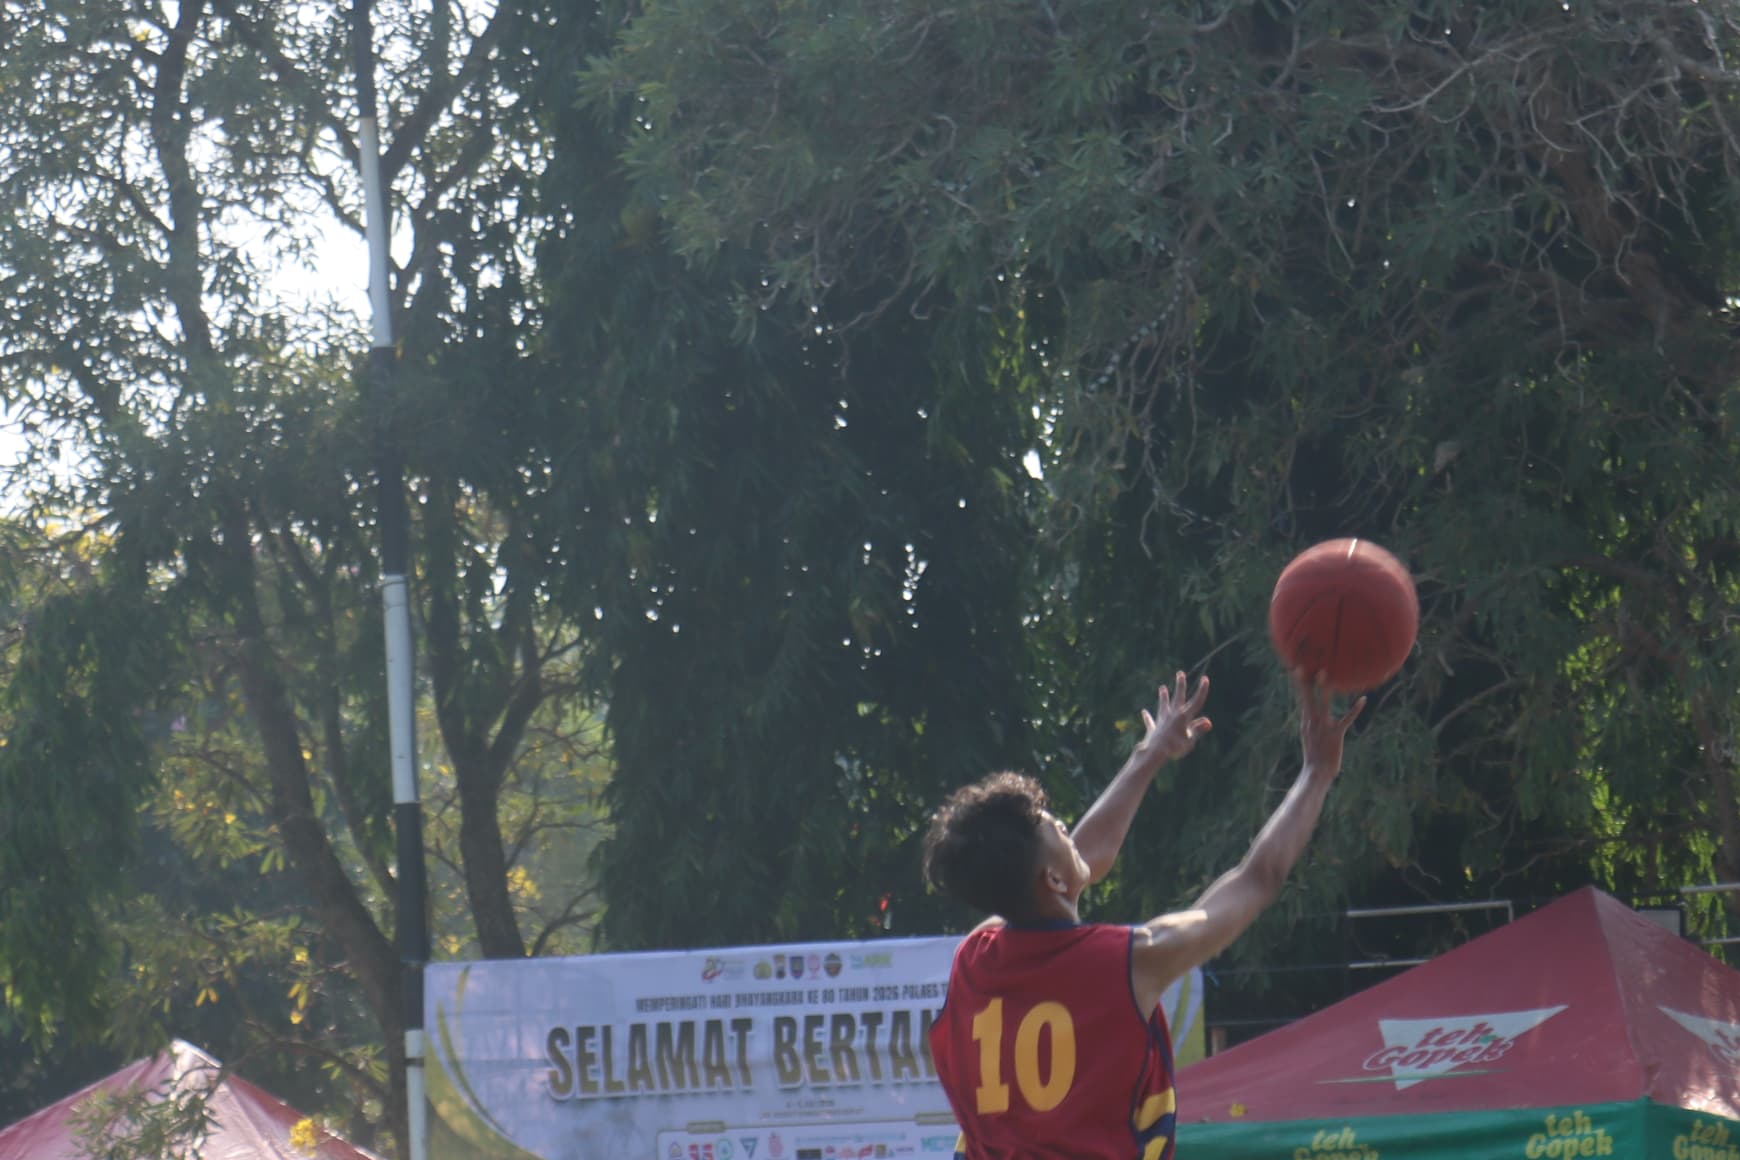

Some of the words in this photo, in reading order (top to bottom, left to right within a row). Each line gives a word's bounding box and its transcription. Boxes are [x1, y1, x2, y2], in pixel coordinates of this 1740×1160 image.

[1416, 1022, 1495, 1049] teh
[546, 1016, 754, 1099] SELAMAT
[972, 997, 1077, 1115] 10
[1363, 1035, 1515, 1071] Gopek
[1545, 1110, 1592, 1137] teh
[1689, 1119, 1731, 1147] teh
[1311, 1126, 1357, 1152] teh
